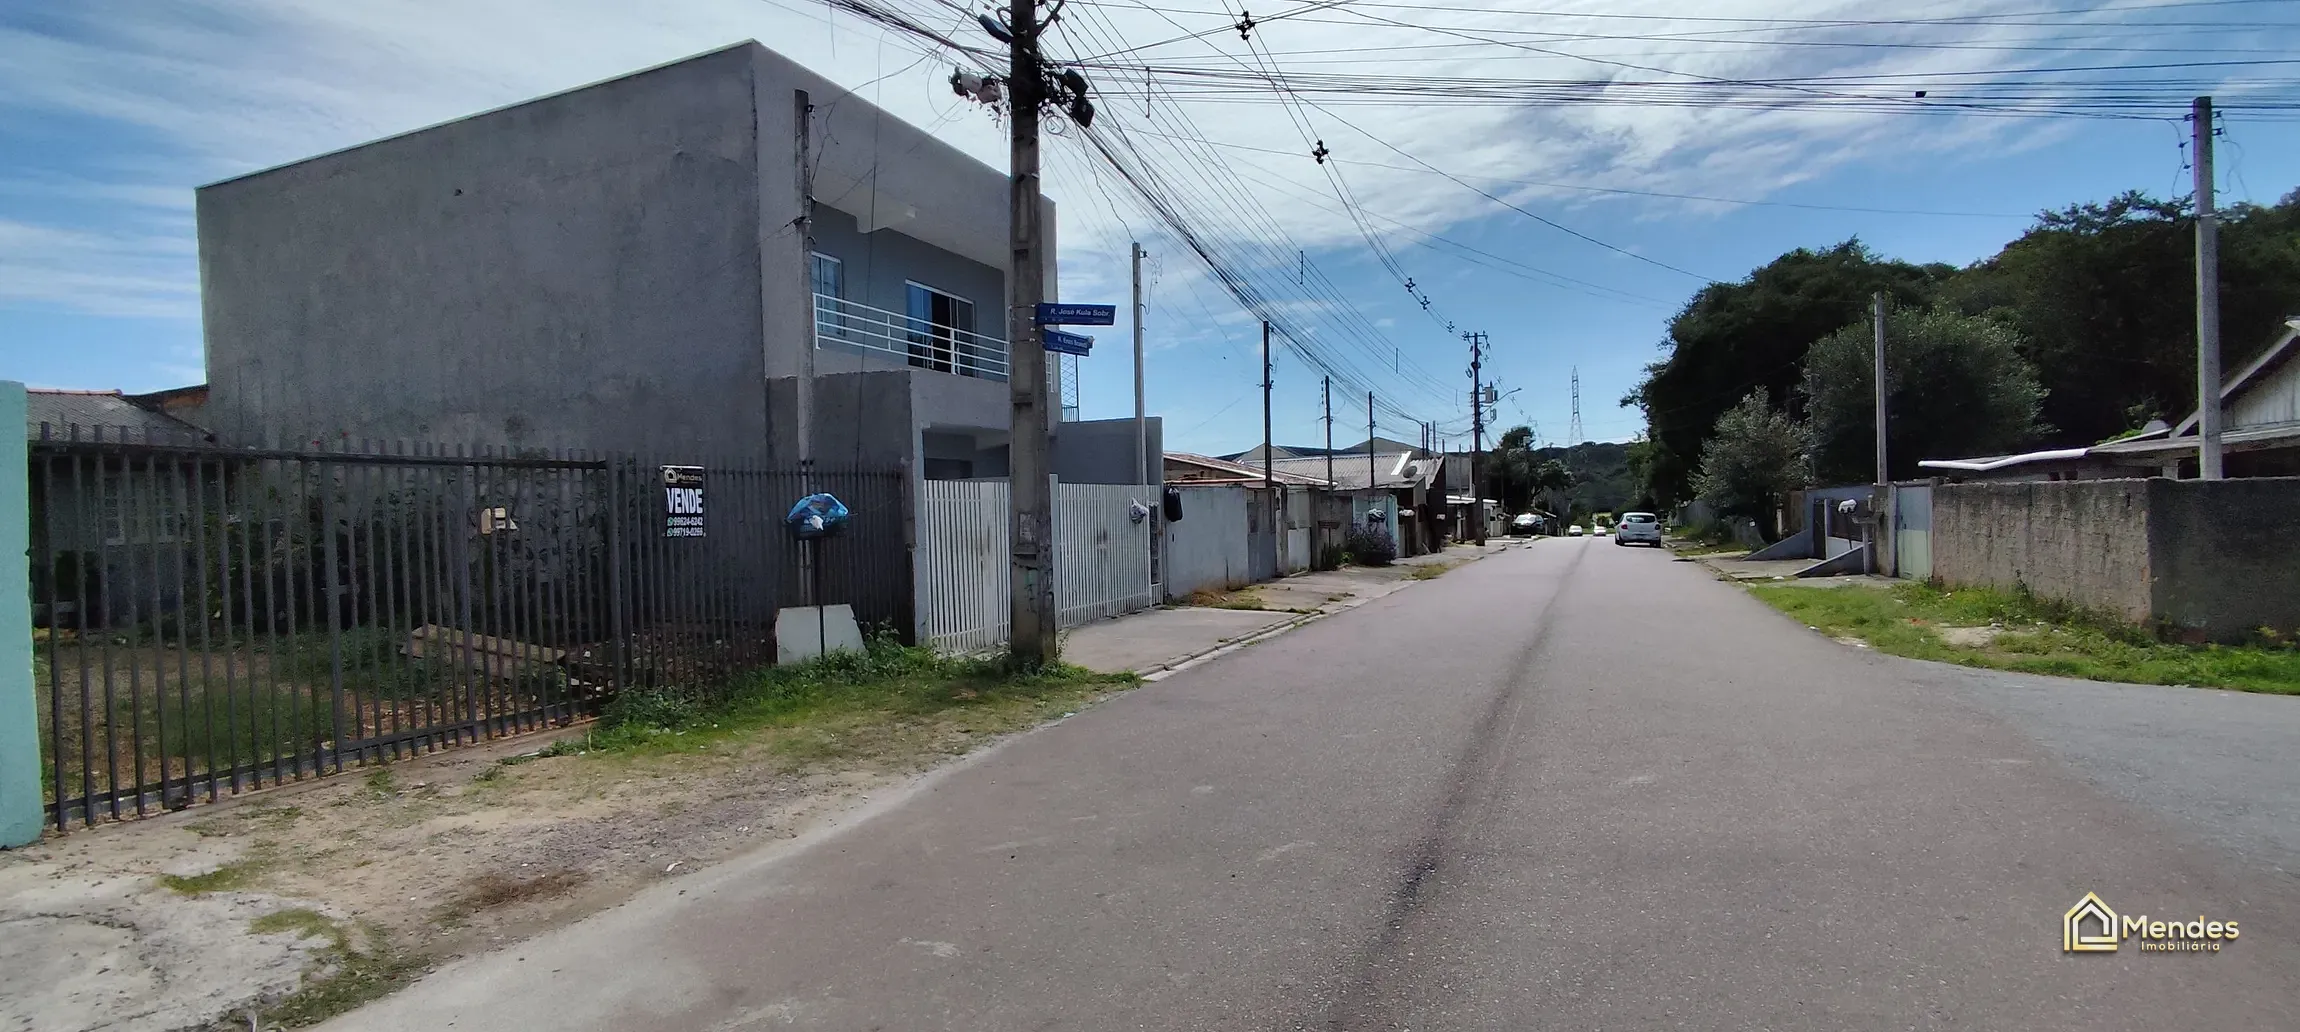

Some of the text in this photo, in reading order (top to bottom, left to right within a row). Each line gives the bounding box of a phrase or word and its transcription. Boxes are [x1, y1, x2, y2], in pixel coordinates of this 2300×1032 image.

[1076, 308, 1092, 316] Kula
[677, 473, 702, 481] Mendes
[666, 488, 703, 513] VENDE
